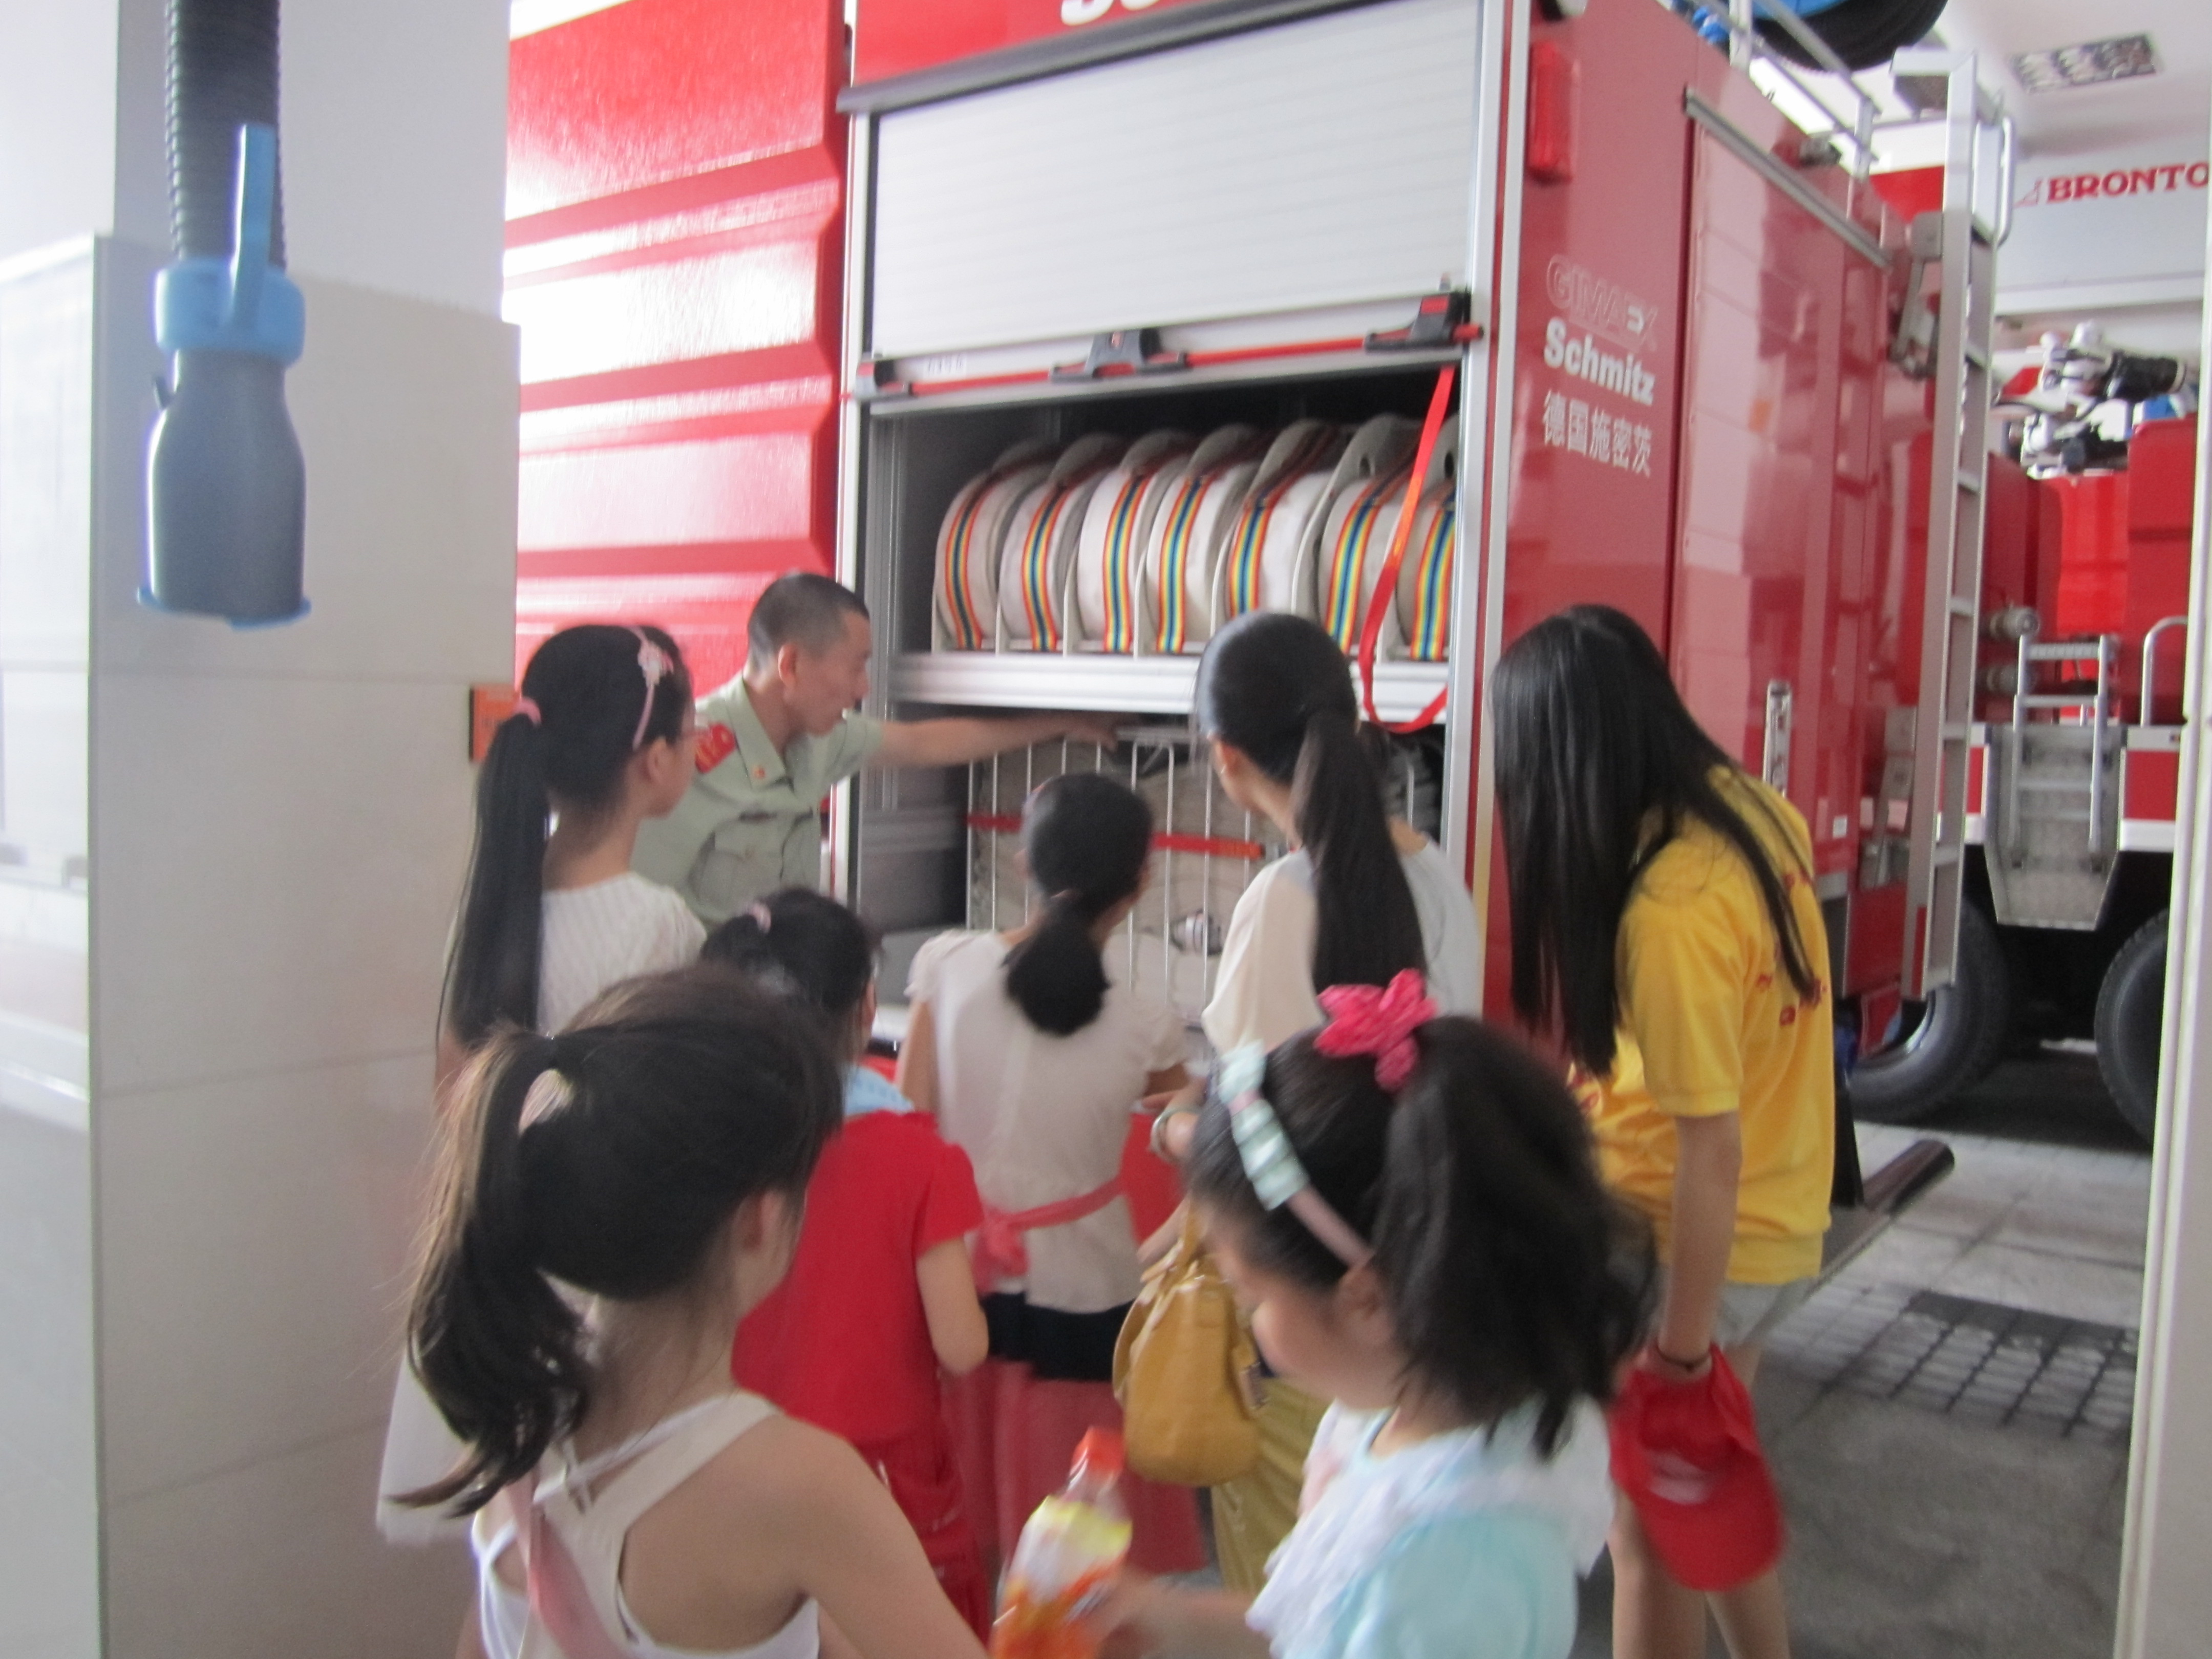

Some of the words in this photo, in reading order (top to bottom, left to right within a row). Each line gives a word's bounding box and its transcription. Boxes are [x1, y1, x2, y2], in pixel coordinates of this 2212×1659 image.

[2047, 160, 2209, 203] BRONTO
[1543, 316, 1656, 407] Schmitz
[1542, 389, 1652, 478] 德国施密茨
